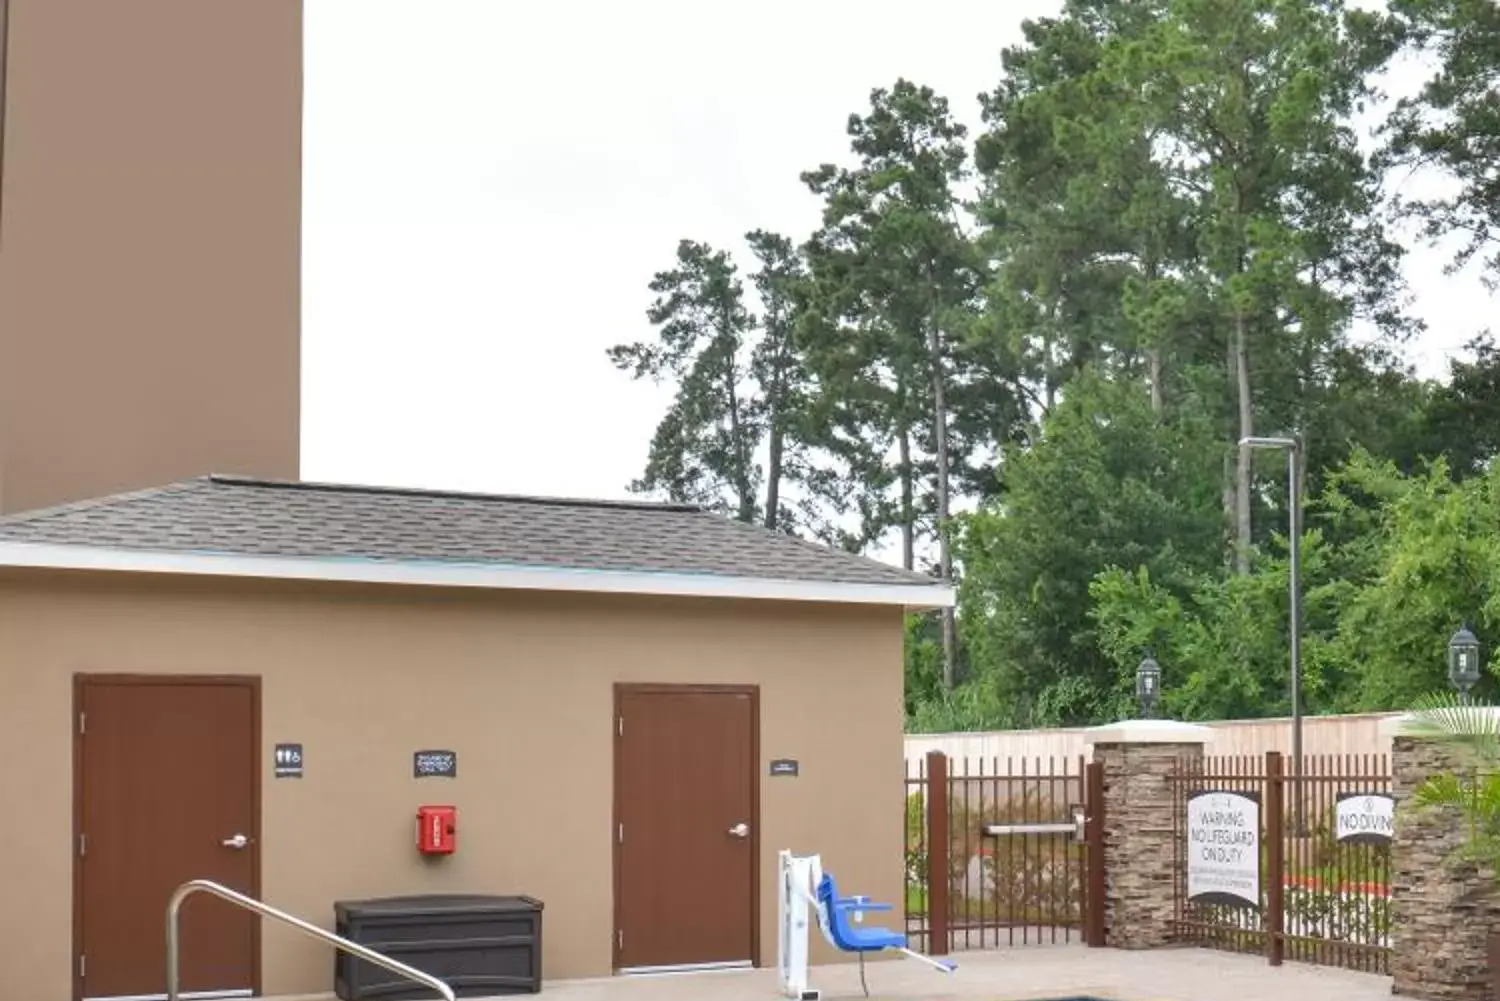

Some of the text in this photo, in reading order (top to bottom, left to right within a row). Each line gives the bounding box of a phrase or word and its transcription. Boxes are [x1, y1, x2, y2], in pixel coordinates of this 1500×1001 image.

[1201, 811, 1245, 827] WARNING
[1341, 813, 1391, 831] NO DIVIN
[1191, 828, 1255, 846] NO LIFEGUARD
[1202, 847, 1243, 862] ON DUTY
